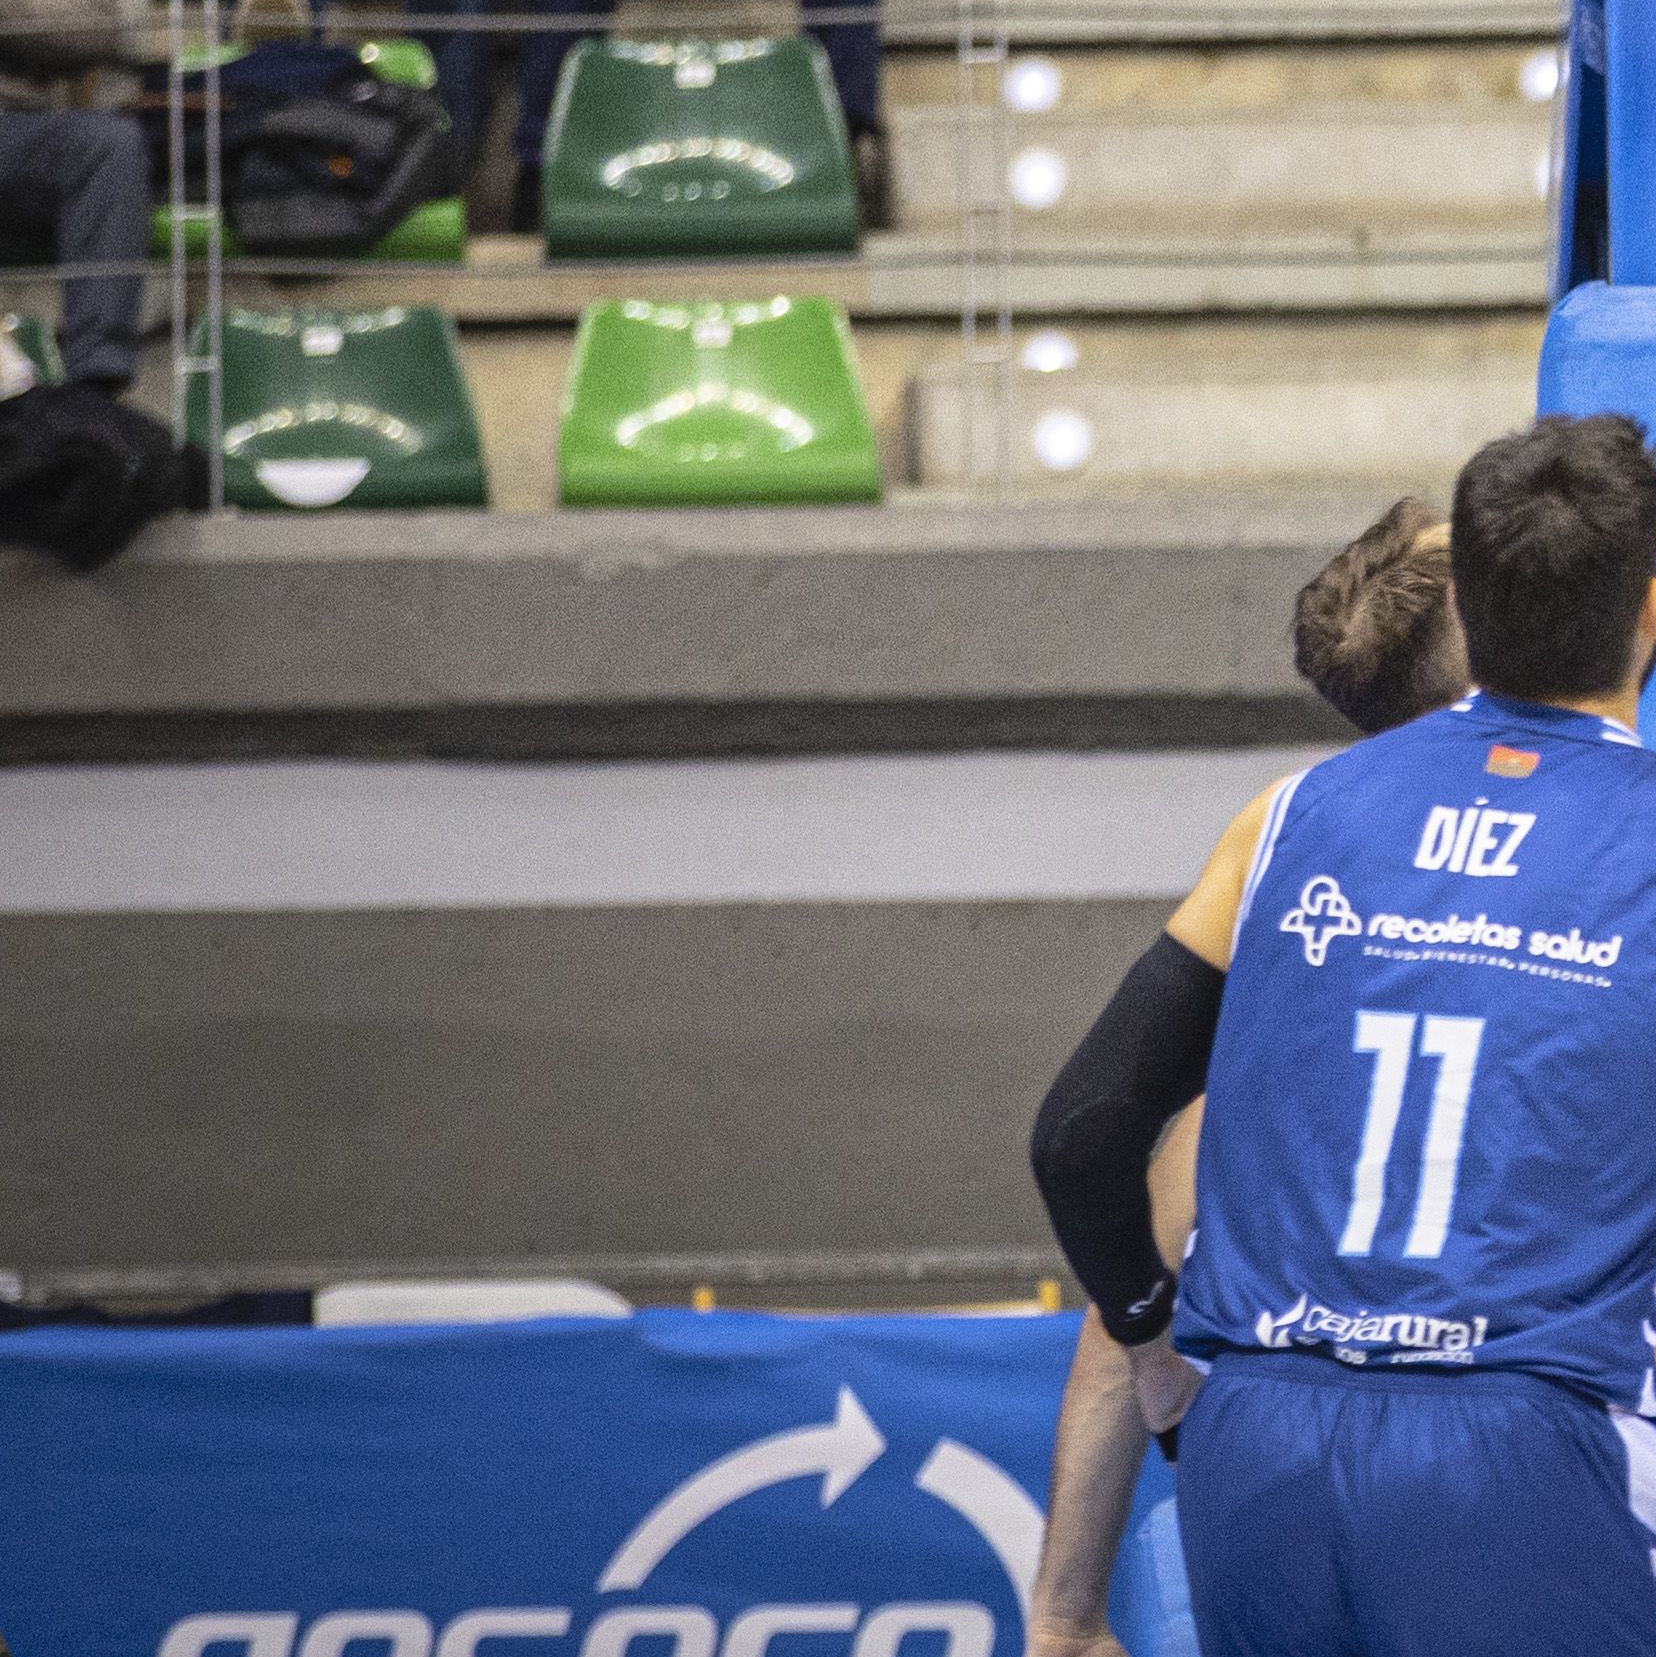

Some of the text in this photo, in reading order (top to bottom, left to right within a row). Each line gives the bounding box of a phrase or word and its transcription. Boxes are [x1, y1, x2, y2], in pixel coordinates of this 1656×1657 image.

[1413, 797, 1537, 877] DÍEZ
[1368, 913, 1622, 967] recoletas salud
[1336, 1011, 1486, 1258] 11
